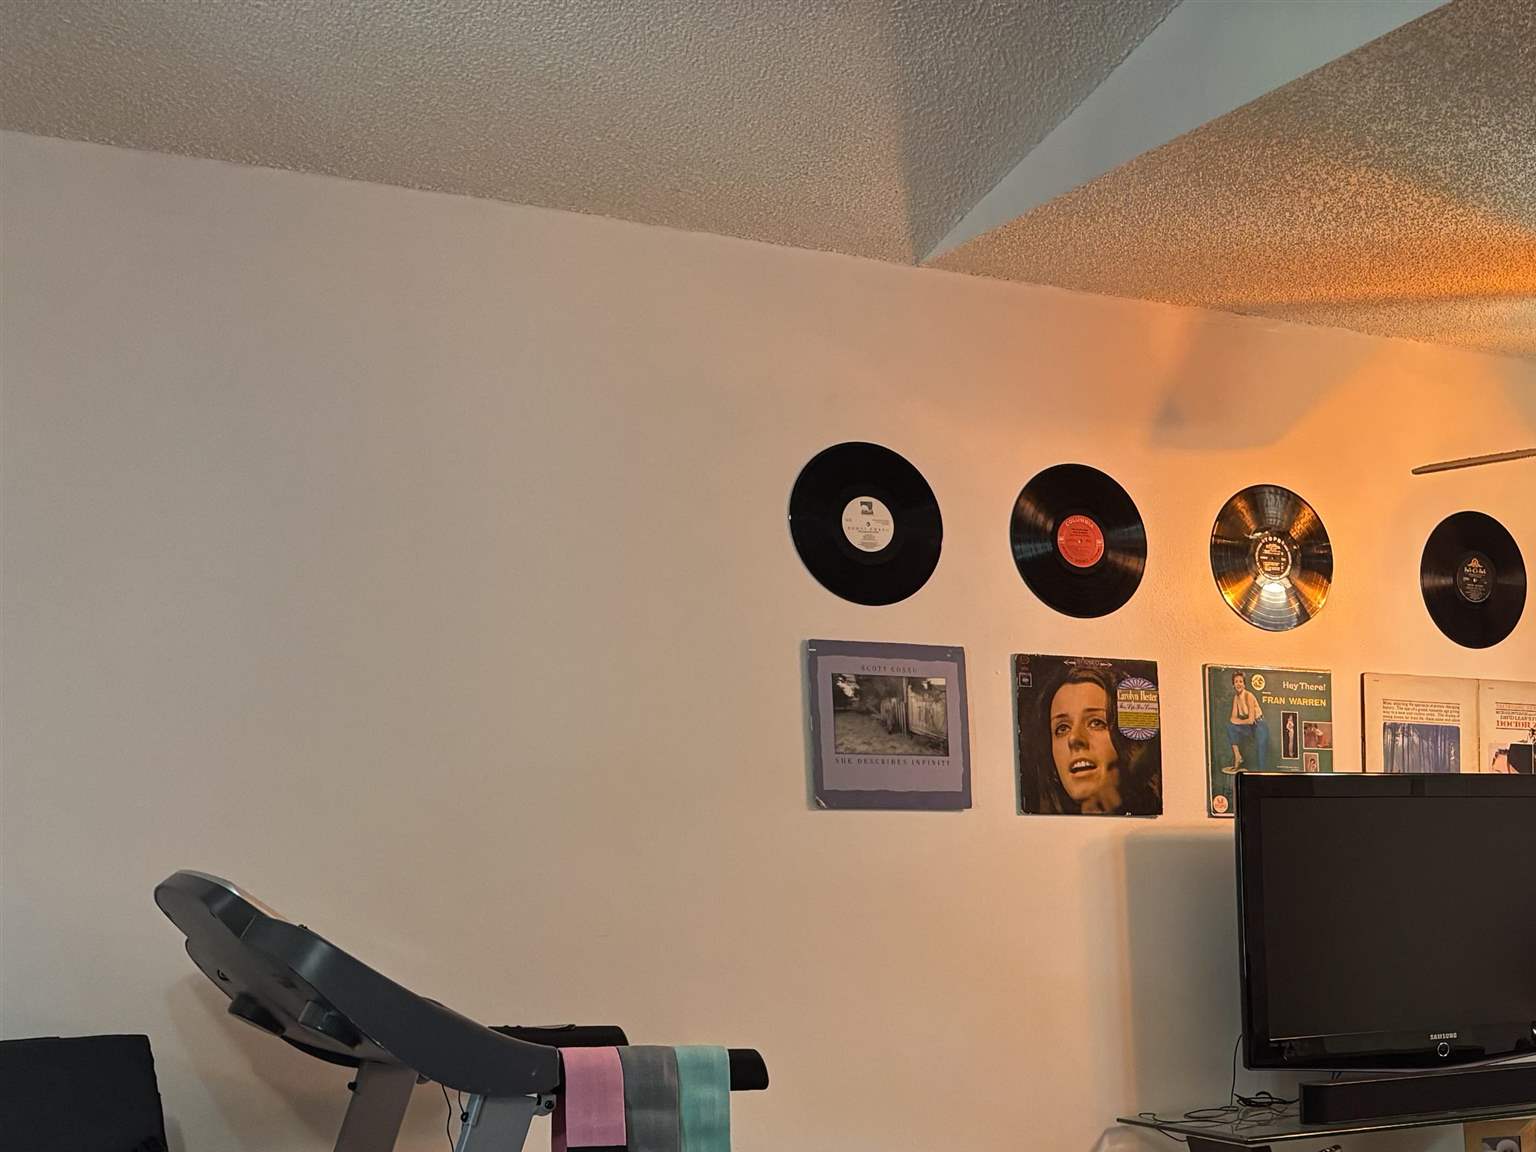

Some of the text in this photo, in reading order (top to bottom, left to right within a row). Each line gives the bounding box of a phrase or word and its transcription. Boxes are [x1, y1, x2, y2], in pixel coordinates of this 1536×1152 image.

[1282, 681, 1326, 691] Hey There!
[1262, 695, 1327, 707] FRAN WARREN
[1496, 720, 1531, 728] DOCTOR
[1429, 1032, 1457, 1040] SAMSUNG
